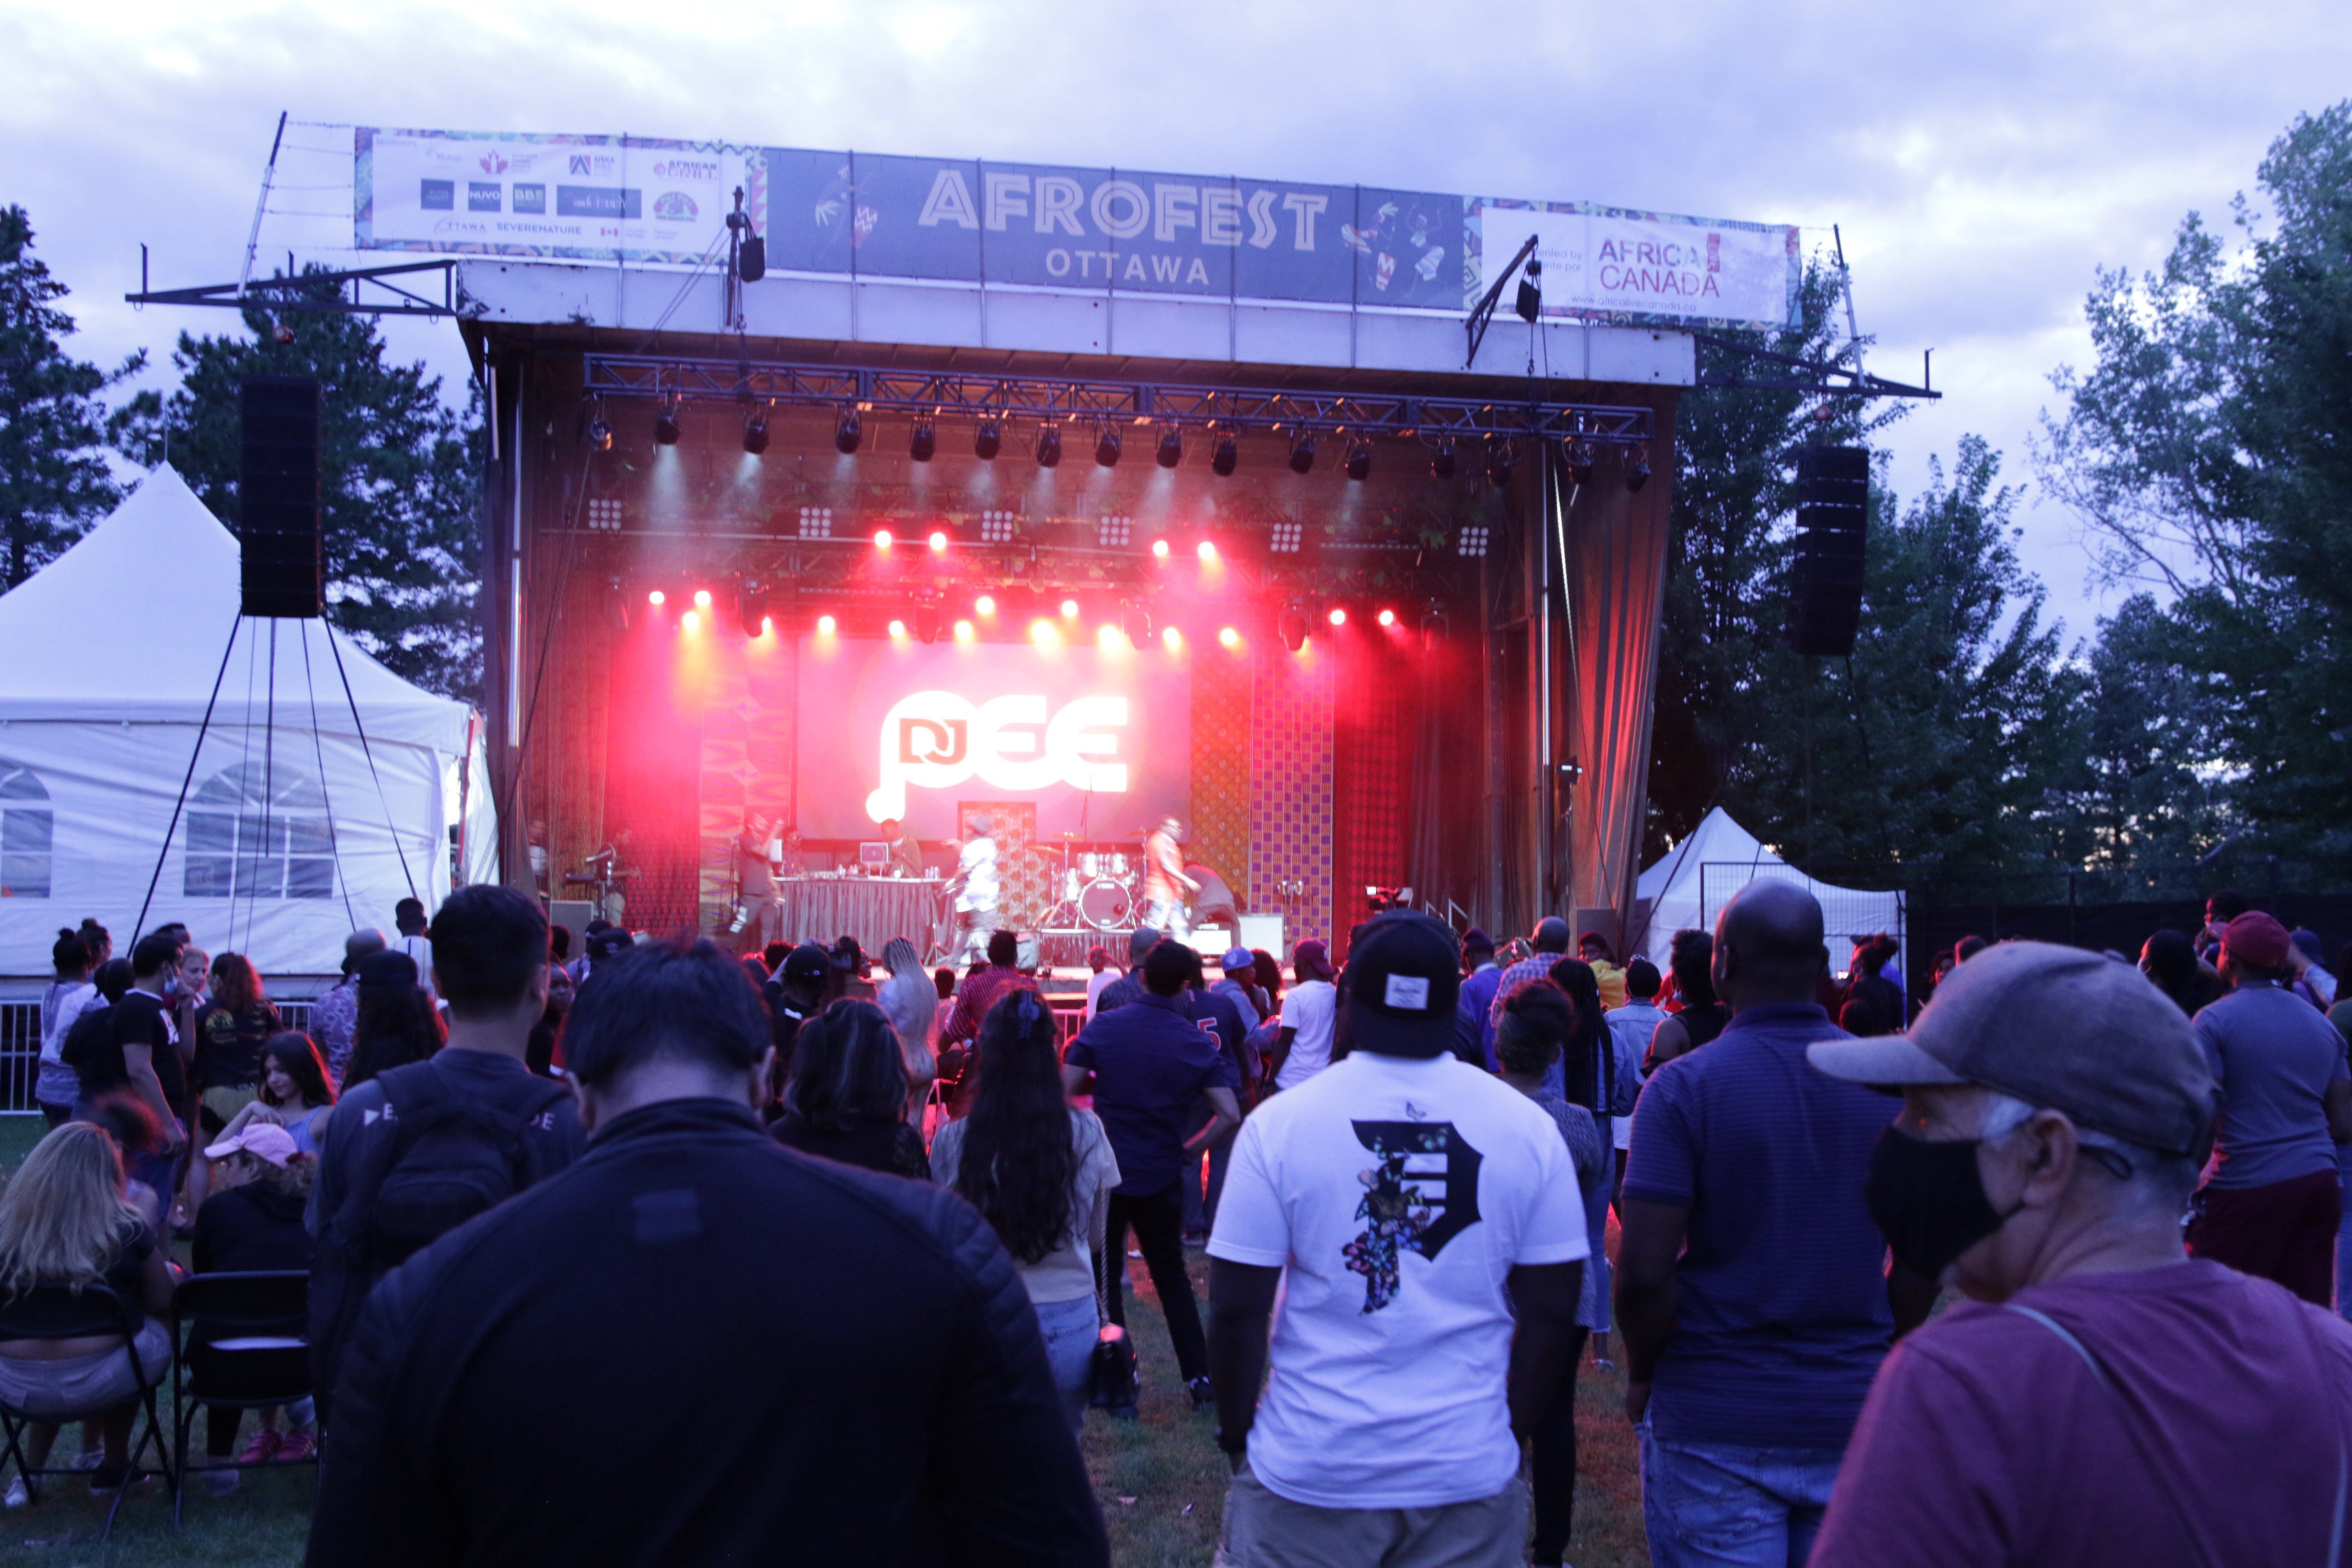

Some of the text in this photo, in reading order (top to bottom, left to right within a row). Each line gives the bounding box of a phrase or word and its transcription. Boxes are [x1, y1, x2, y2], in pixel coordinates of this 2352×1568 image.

[469, 190, 501, 201] NUVO
[918, 168, 1329, 251] AFROFEST
[497, 221, 582, 235] SEVERENATURE
[1570, 249, 1582, 261] by
[1598, 238, 1701, 269] AFRICA
[1045, 248, 1209, 285] OTTAWA
[1565, 263, 1581, 272] par
[1600, 265, 1720, 298] CANADA
[1571, 295, 1696, 312] www.africalivecanada.ca
[899, 718, 967, 766] DJ
[1511, 940, 1518, 954] 1
